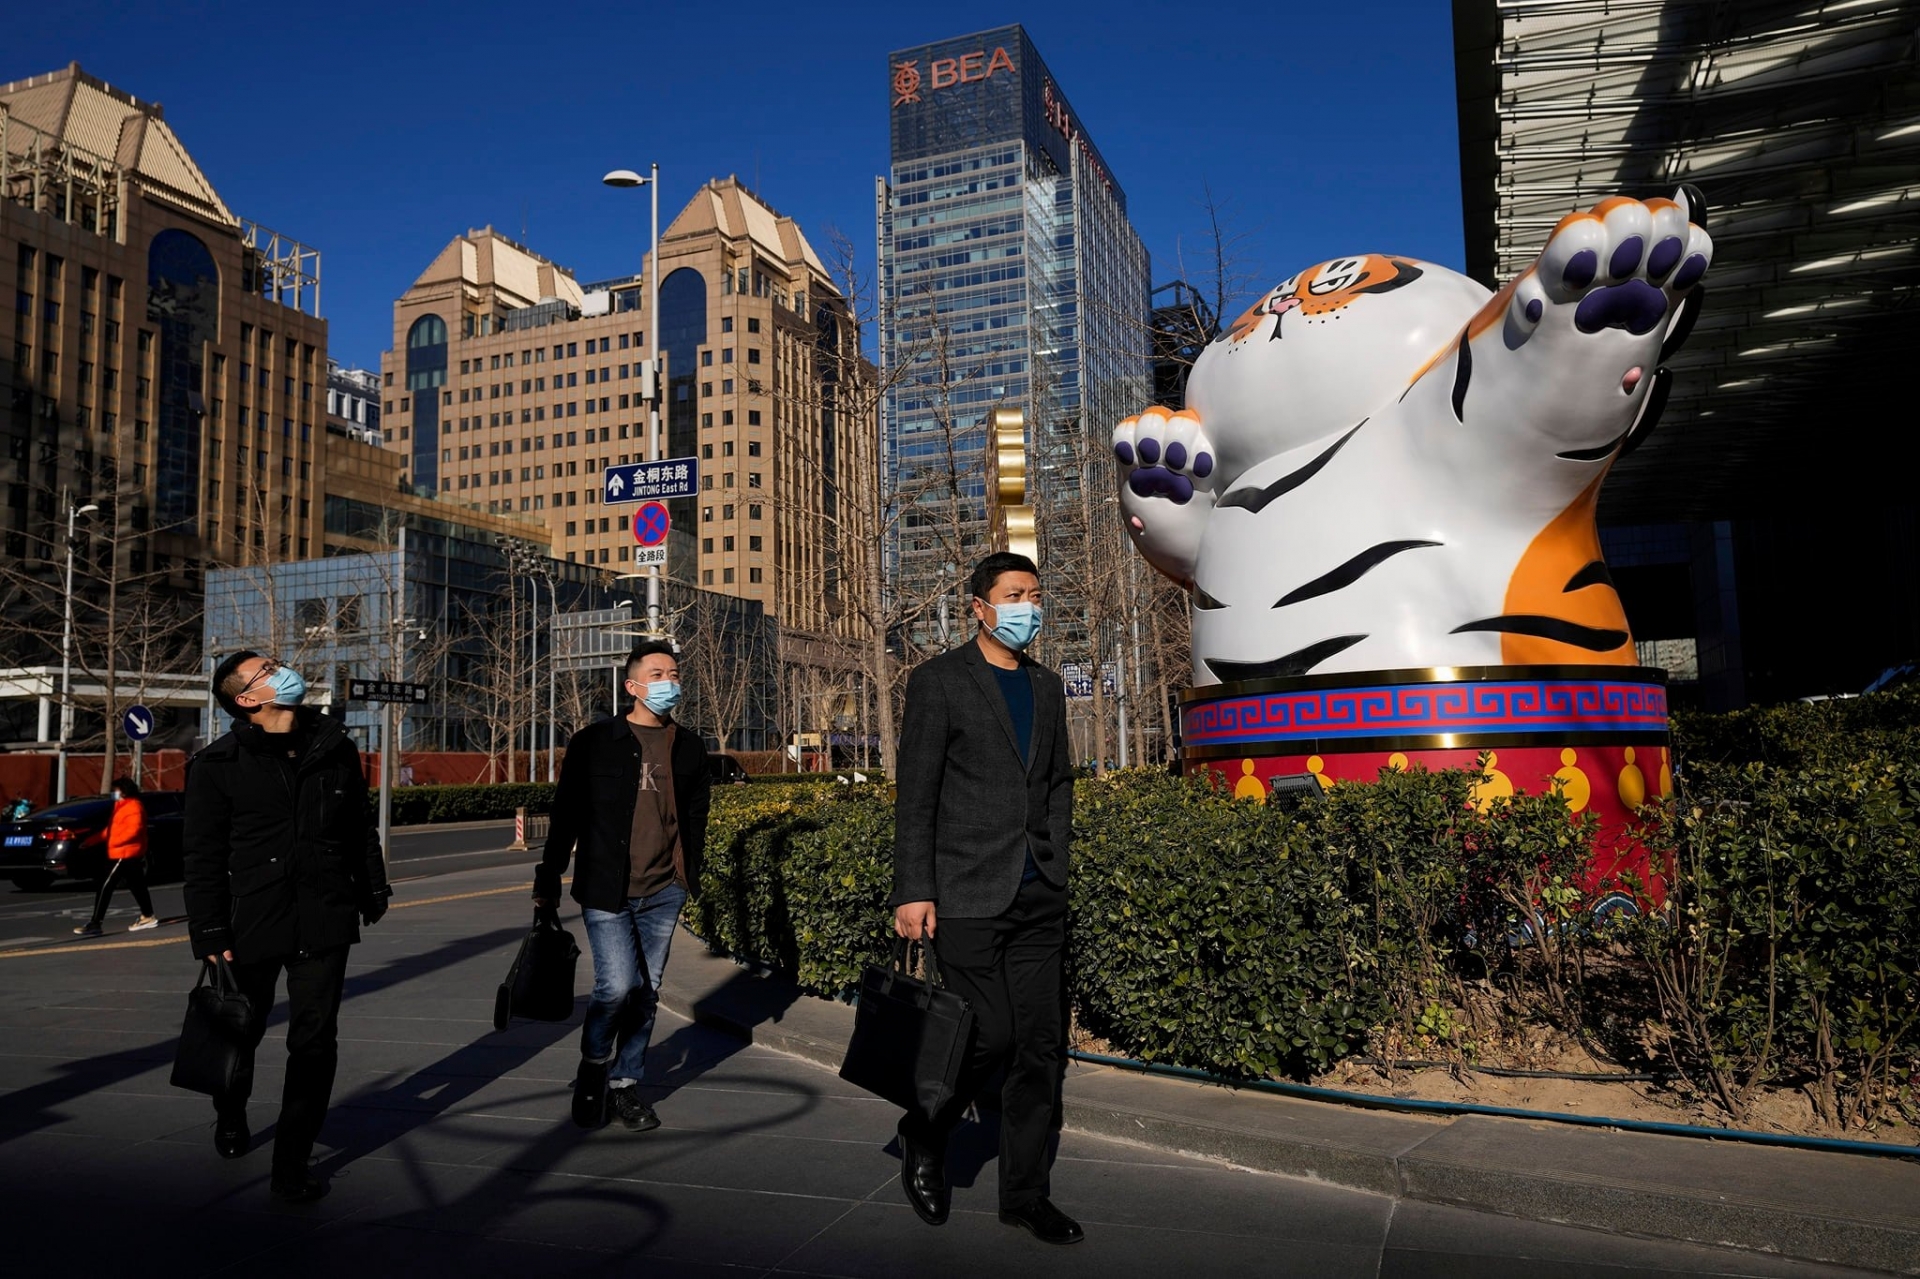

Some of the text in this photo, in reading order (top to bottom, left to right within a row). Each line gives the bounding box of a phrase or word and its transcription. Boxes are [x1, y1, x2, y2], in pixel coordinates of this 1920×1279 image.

[931, 46, 1016, 90] BEA
[632, 464, 689, 485] 金桐东路
[632, 481, 689, 497] JINTONG East Rd
[638, 549, 665, 563] 全路段
[367, 682, 413, 695] 金桐东路
[639, 762, 662, 793] K
